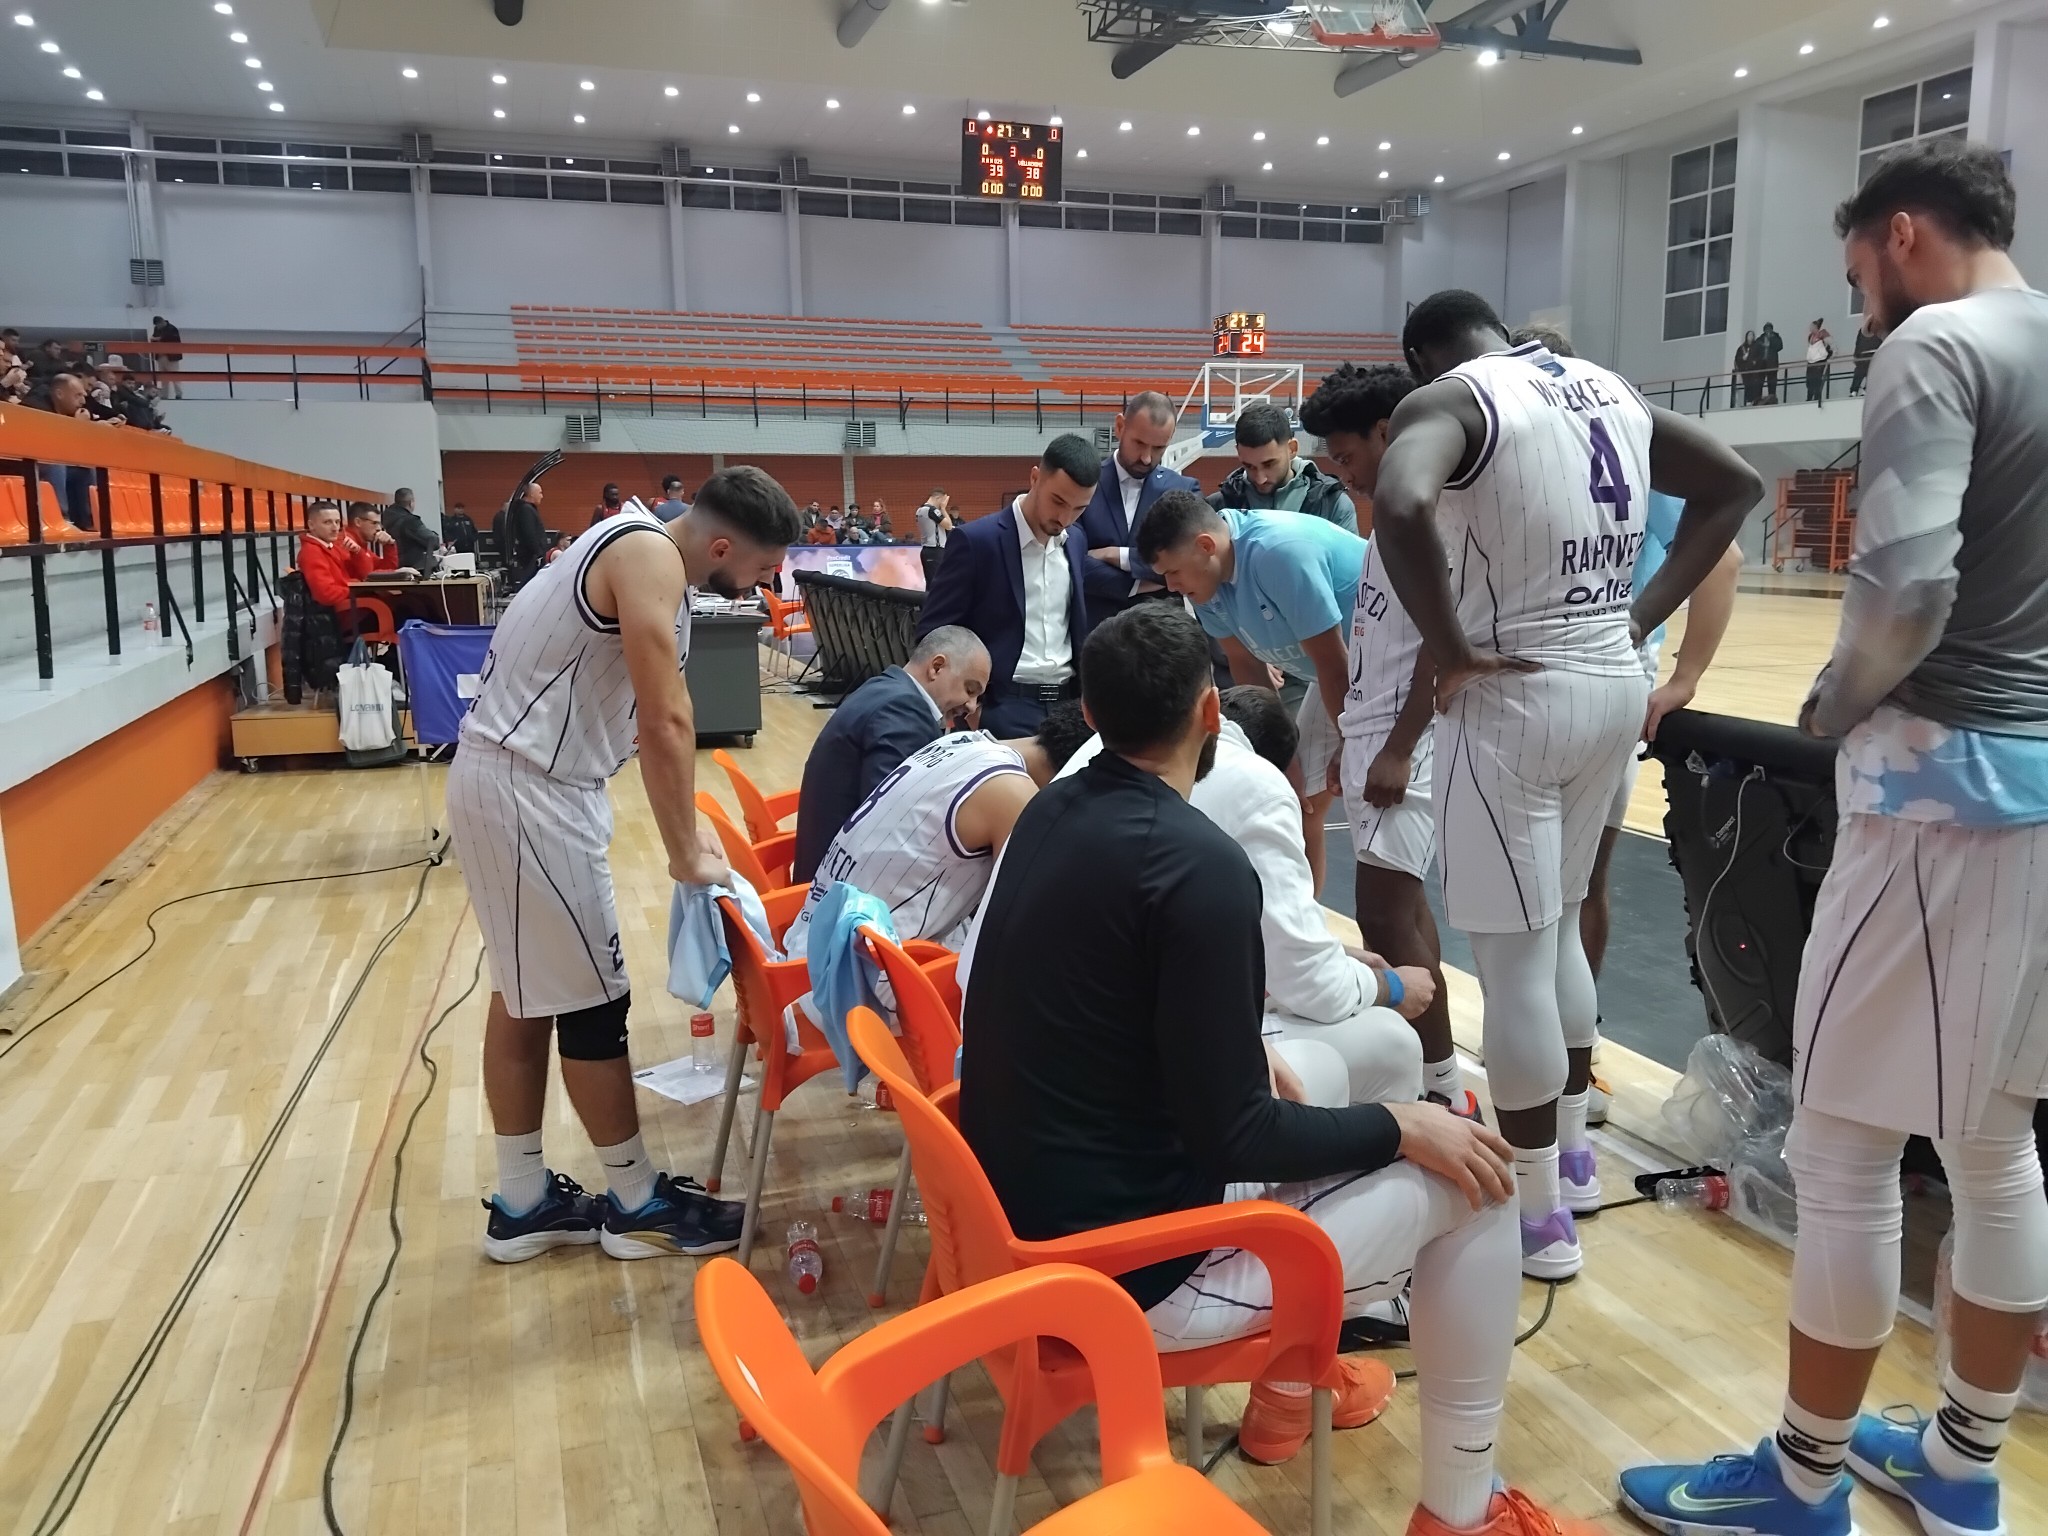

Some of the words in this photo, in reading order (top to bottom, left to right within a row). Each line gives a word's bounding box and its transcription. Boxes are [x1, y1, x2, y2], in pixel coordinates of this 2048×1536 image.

[989, 164, 1004, 177] 39
[1025, 167, 1040, 180] 38
[1242, 334, 1265, 352] 24
[1588, 417, 1632, 522] 4
